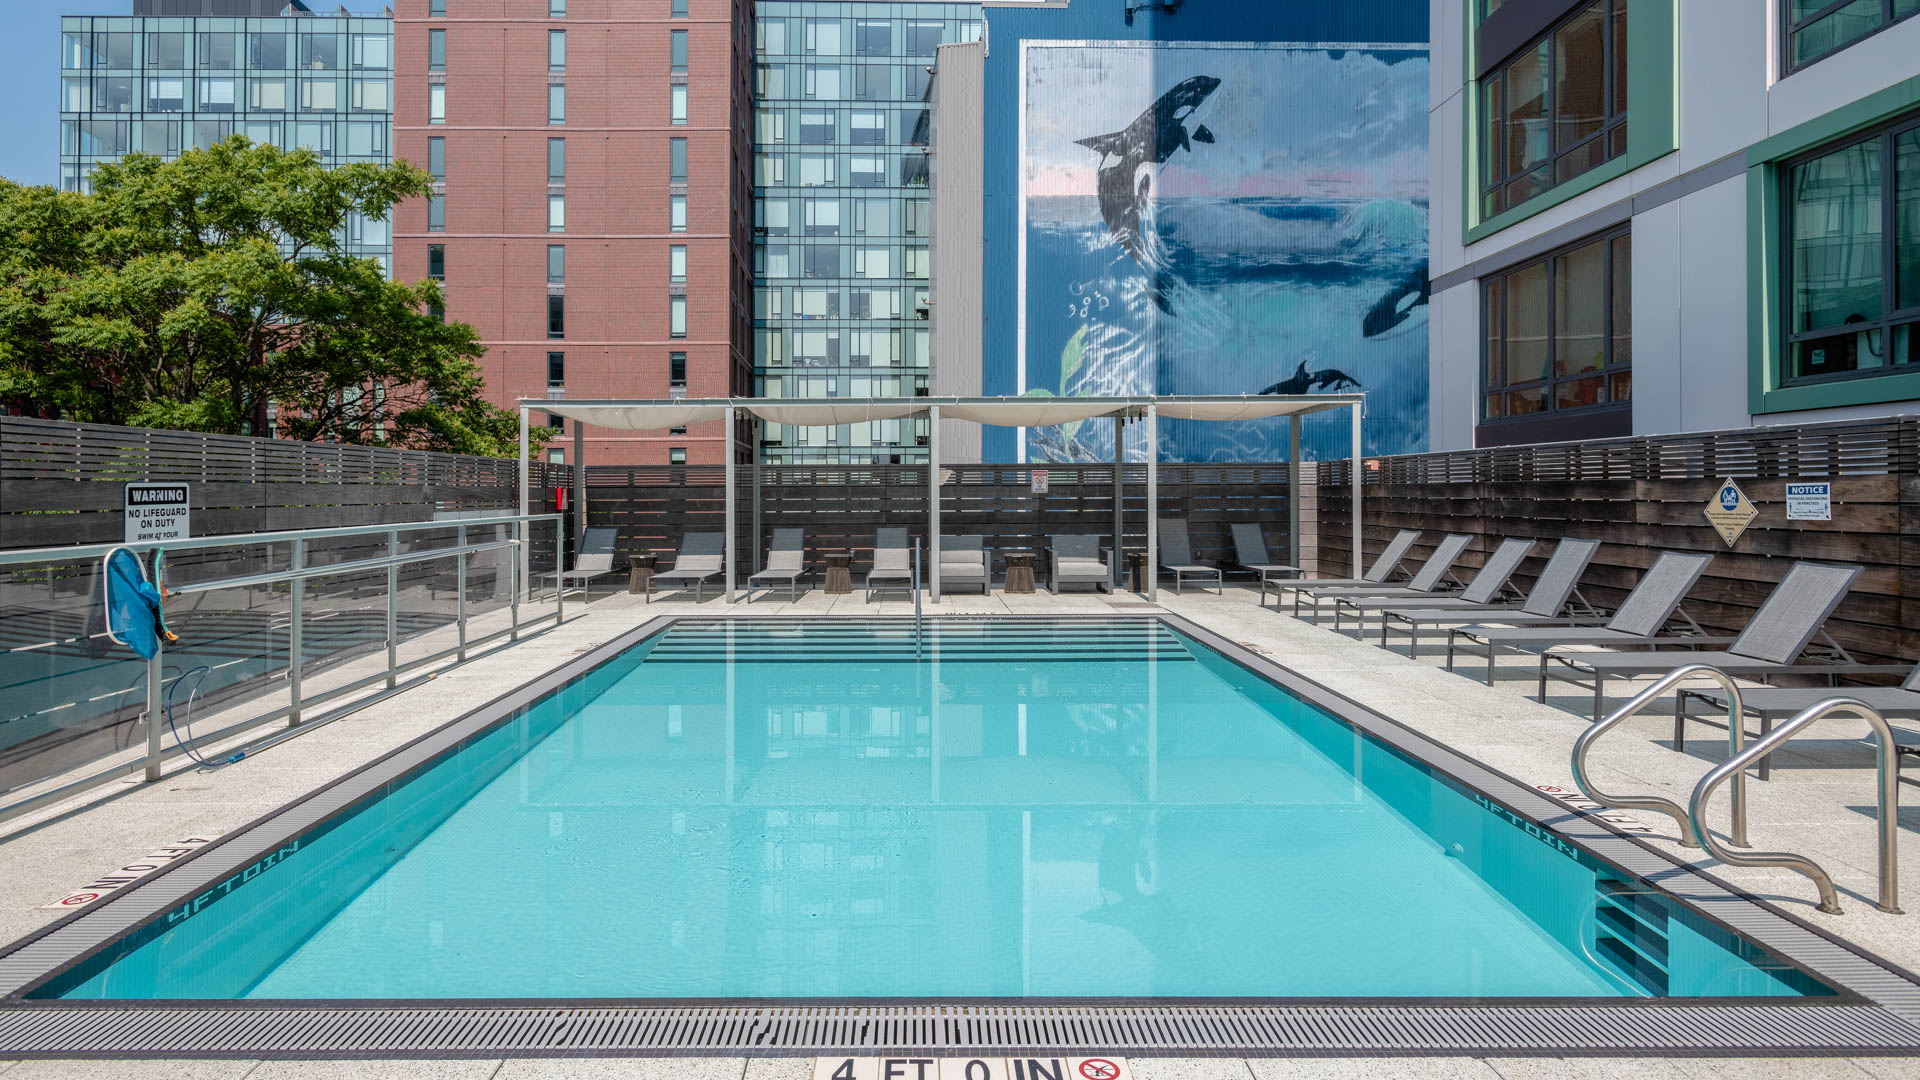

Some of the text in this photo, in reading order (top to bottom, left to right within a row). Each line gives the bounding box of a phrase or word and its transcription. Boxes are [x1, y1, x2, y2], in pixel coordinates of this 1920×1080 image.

[132, 489, 184, 502] WARNING
[1791, 486, 1824, 494] NOTICE
[128, 507, 187, 518] NO LIFEGUARD
[140, 518, 175, 529] ON DUTY
[137, 531, 179, 541] SWIM AT YOUR
[831, 1058, 857, 1080] 4
[884, 1059, 934, 1080] FT
[1013, 1058, 1064, 1080] IN
